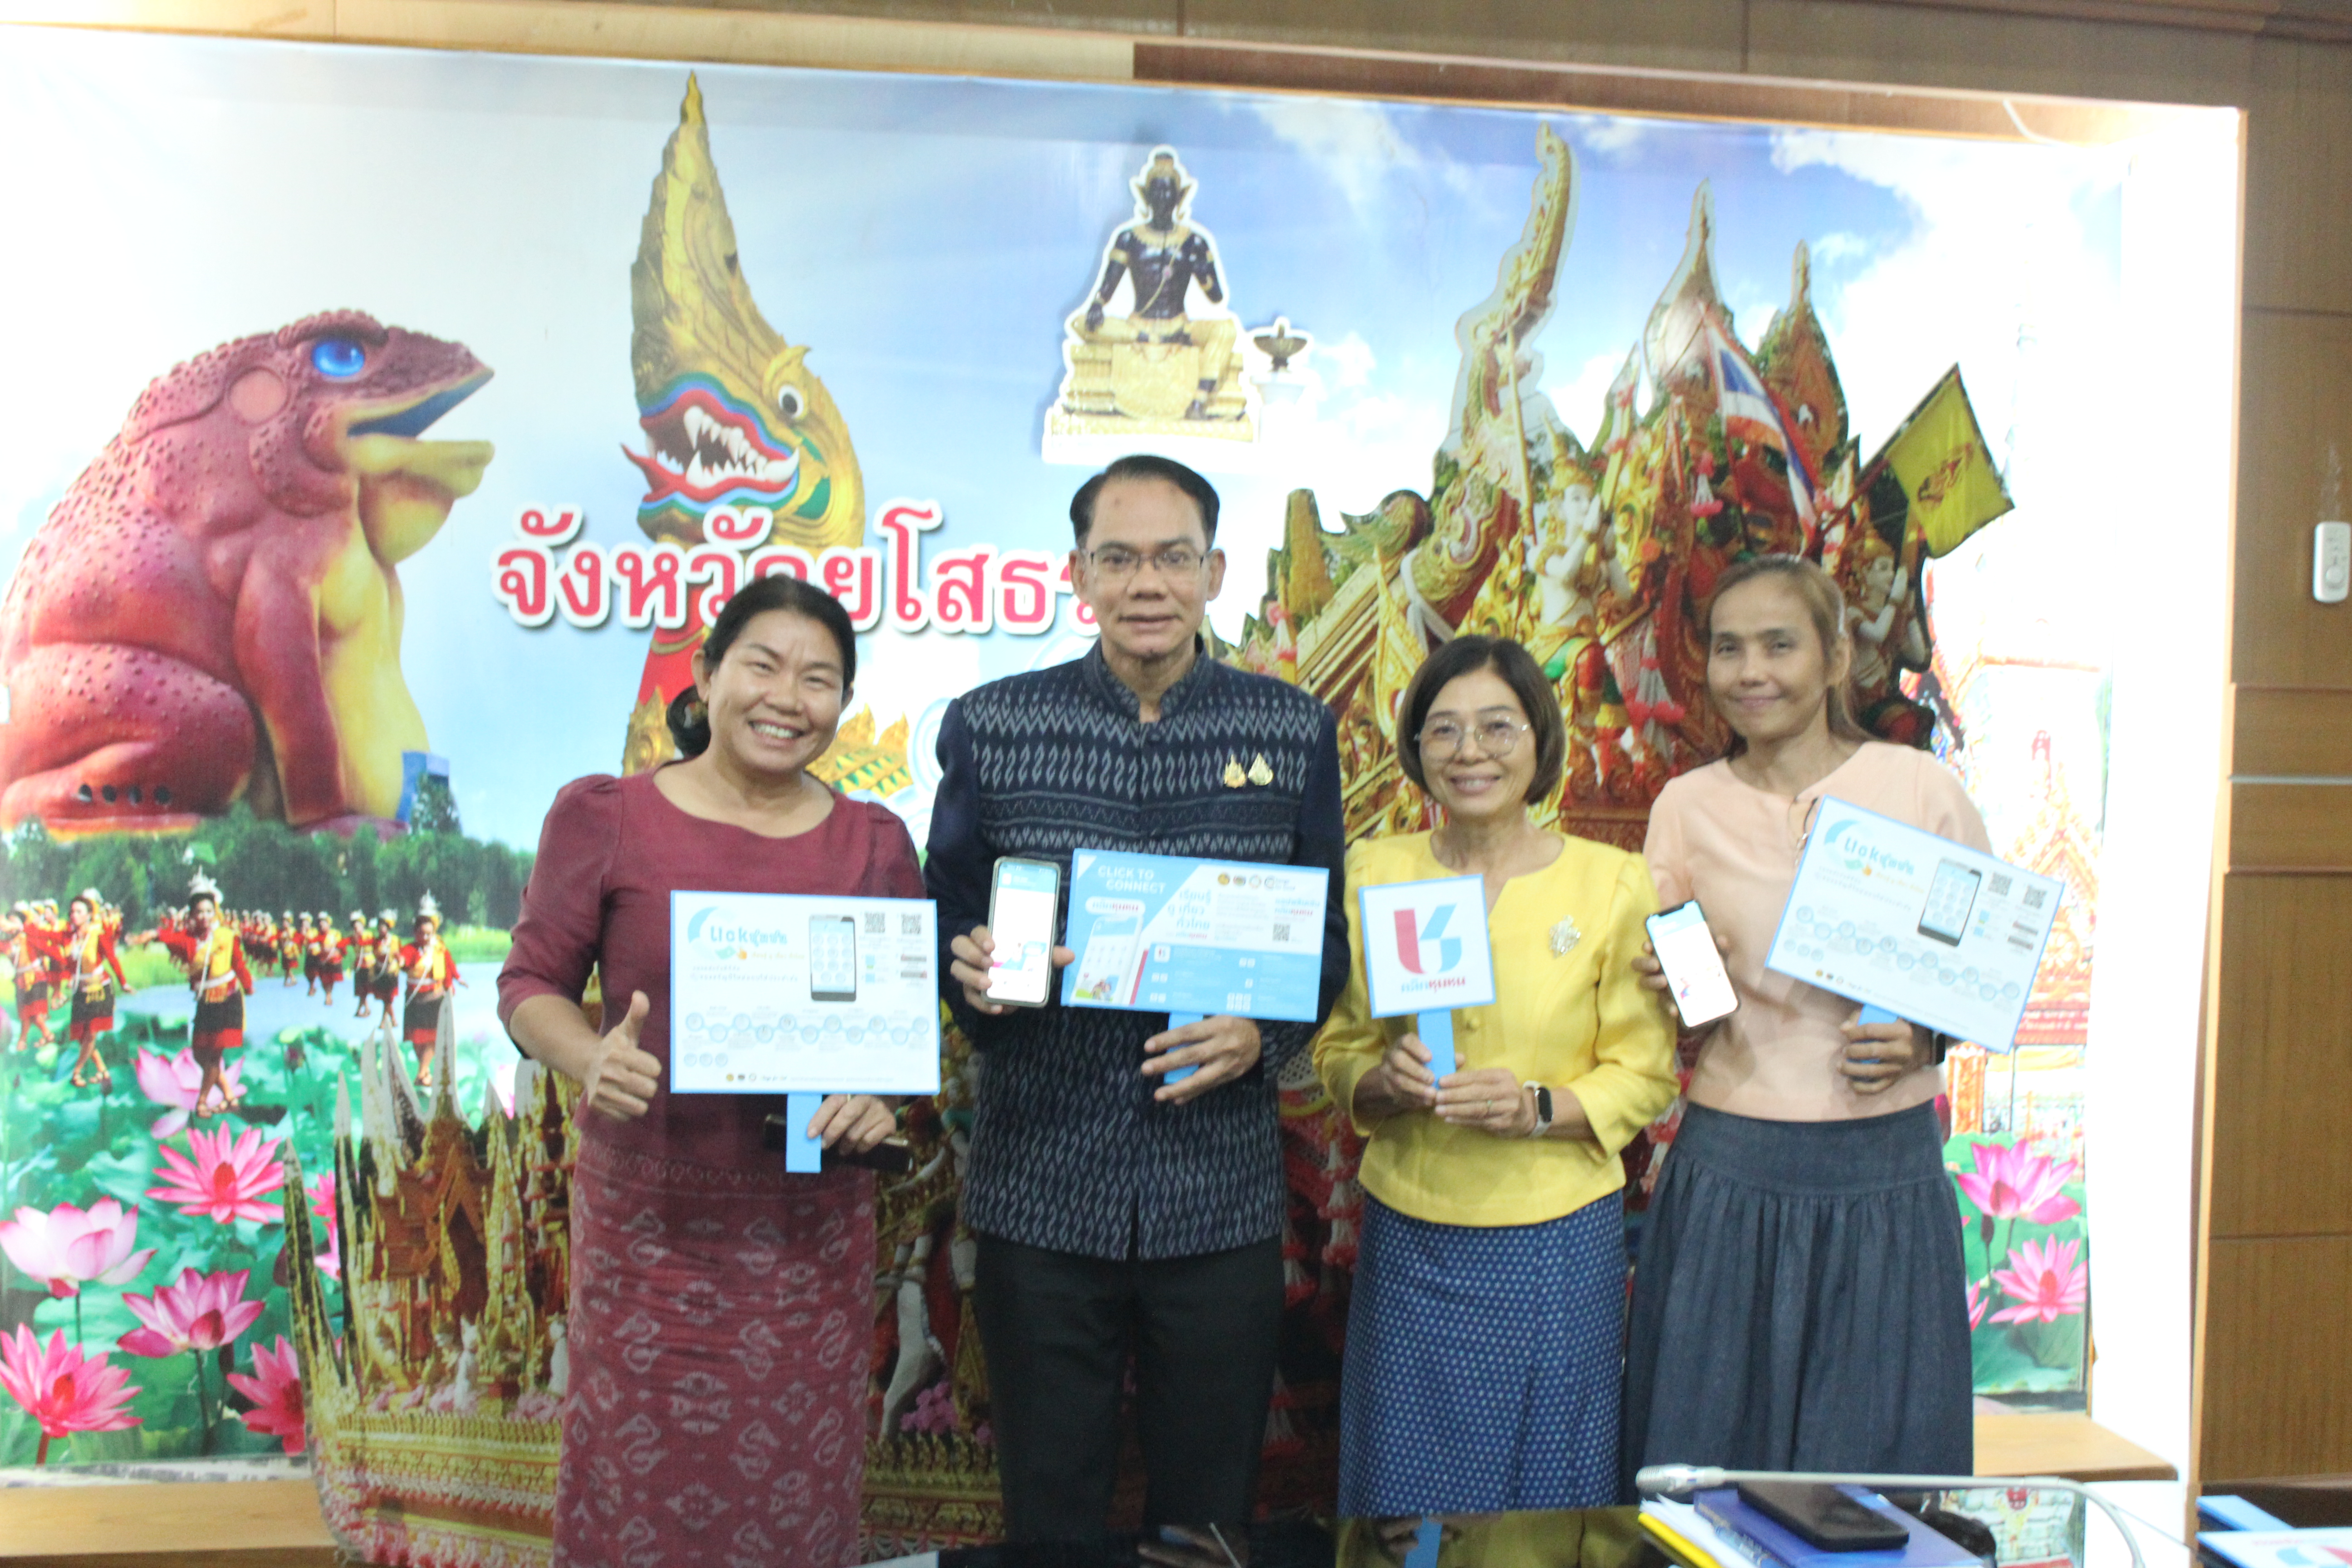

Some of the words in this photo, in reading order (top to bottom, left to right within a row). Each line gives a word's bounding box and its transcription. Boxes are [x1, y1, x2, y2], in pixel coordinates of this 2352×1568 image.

[1098, 865, 1134, 879] CLICK
[1137, 868, 1155, 881] TO
[1106, 879, 1166, 894] CONNECT
